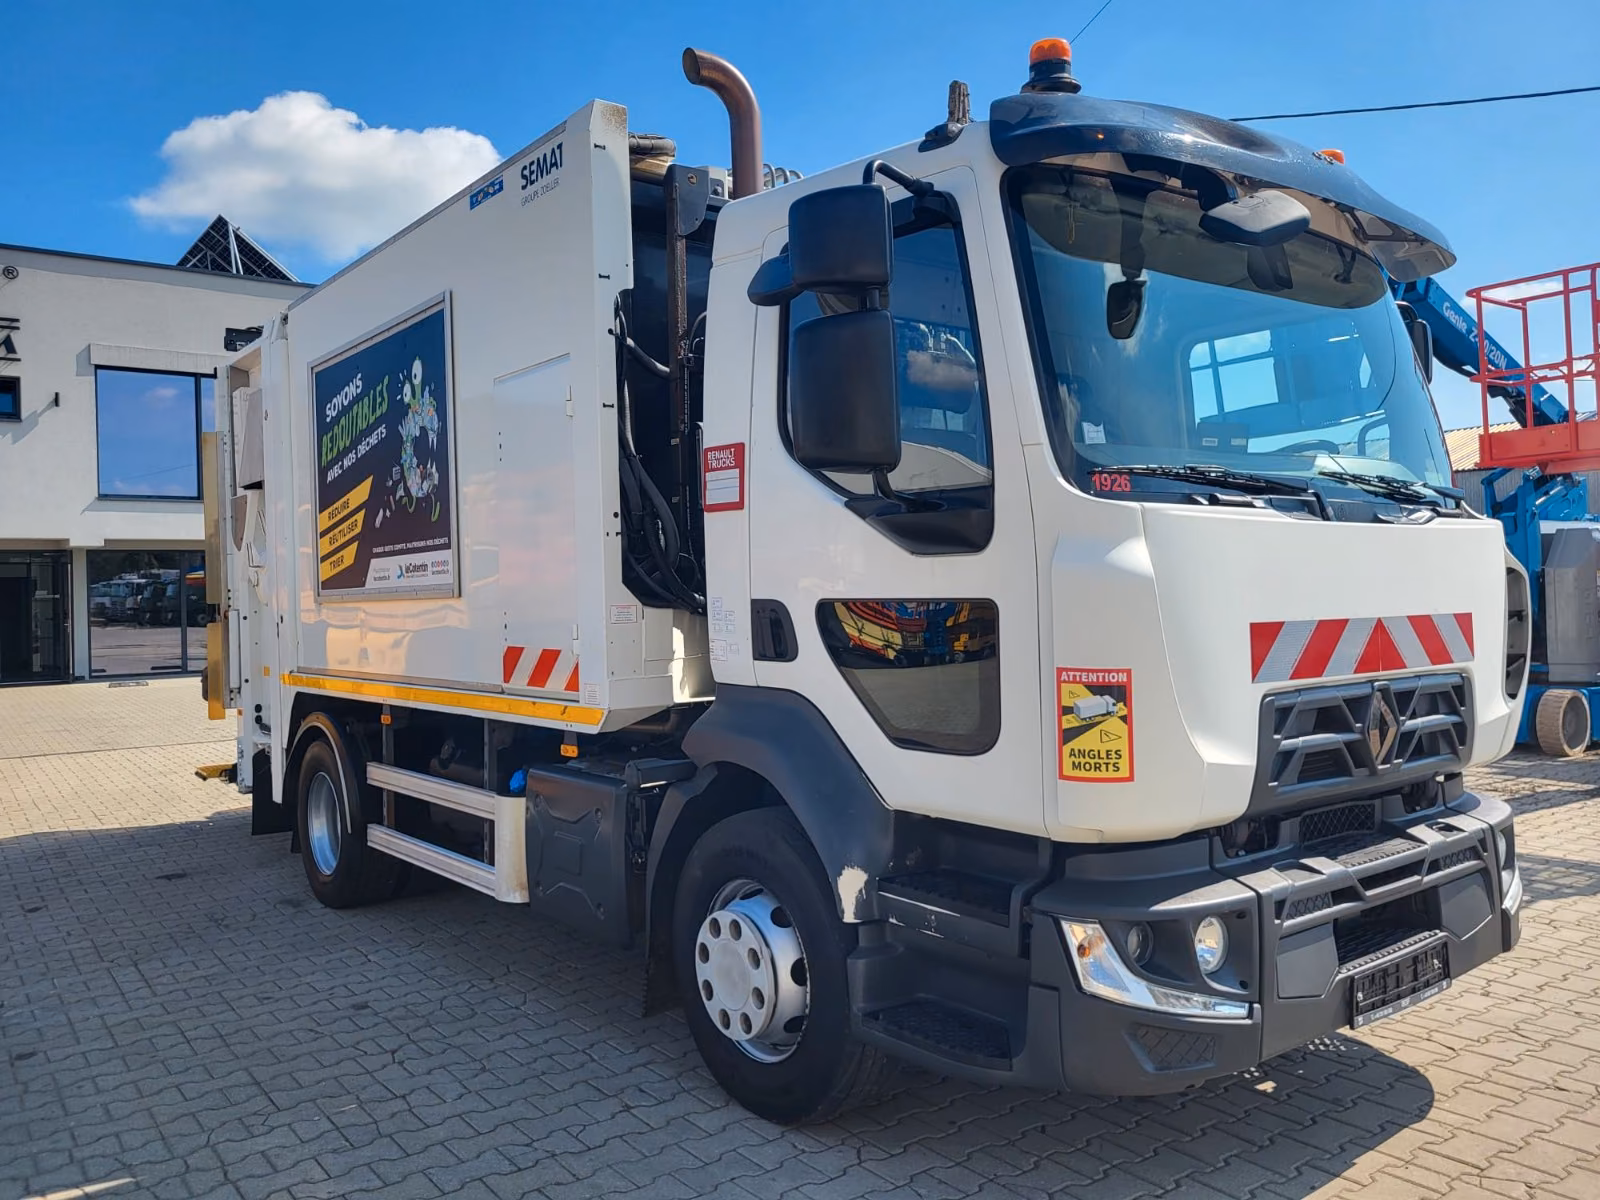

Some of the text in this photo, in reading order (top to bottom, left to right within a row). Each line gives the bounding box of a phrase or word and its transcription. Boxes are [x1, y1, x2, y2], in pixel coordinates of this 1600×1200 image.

[520, 141, 563, 190] SEMAT
[520, 189, 539, 207] GROUPE
[1443, 302, 1467, 334] Genie
[326, 372, 362, 423] SOYONS
[321, 374, 389, 468] REDOUTABLES
[326, 423, 386, 485] AVEC NOS DÉCHETS
[707, 448, 735, 461] RENAULT
[707, 458, 735, 469] TRUCKS
[1091, 473, 1131, 492] 1926
[329, 555, 344, 572] TRIER
[1060, 671, 1128, 683] ATTENTION
[1068, 747, 1123, 761] ANGLES
[1071, 761, 1121, 773] MORTS
